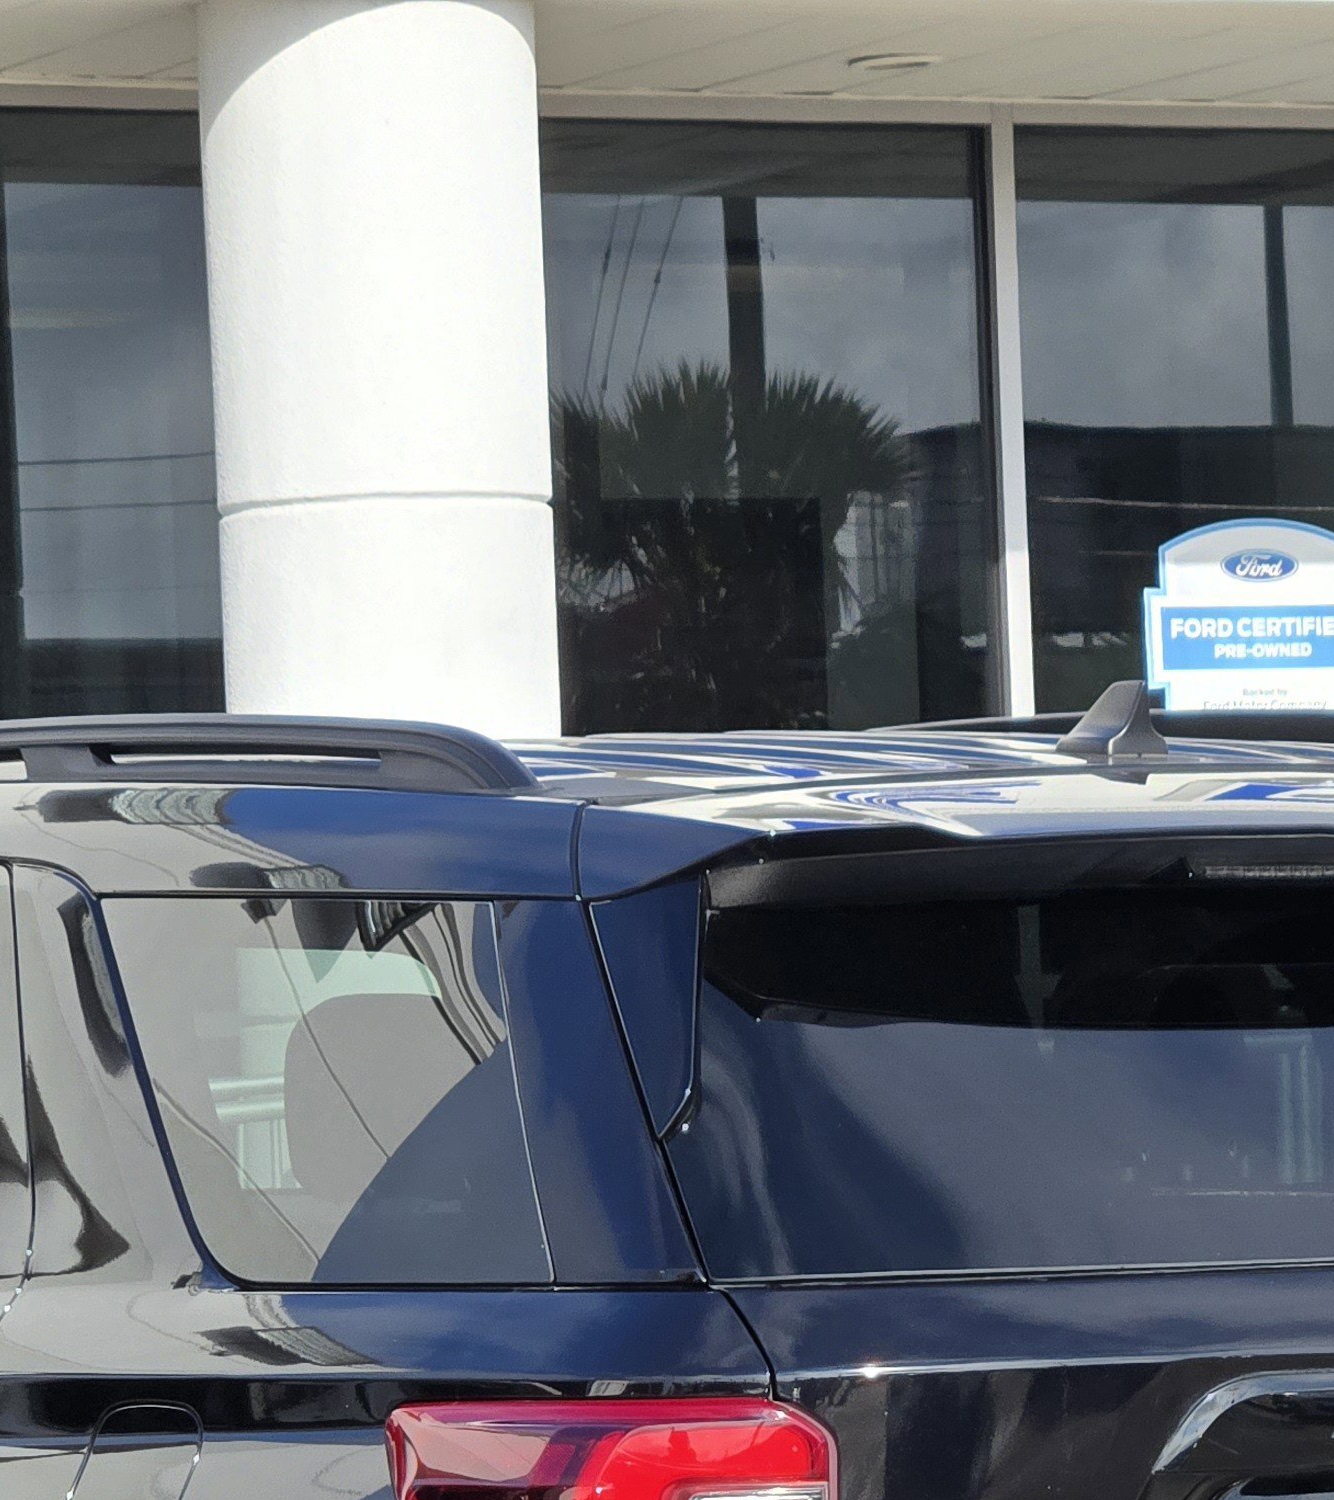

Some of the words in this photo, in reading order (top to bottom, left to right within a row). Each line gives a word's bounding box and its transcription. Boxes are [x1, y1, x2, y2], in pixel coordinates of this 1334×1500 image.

[1236, 555, 1282, 577] Ford
[1170, 617, 1234, 639] FORD
[1214, 642, 1313, 659] PRE-OWNED
